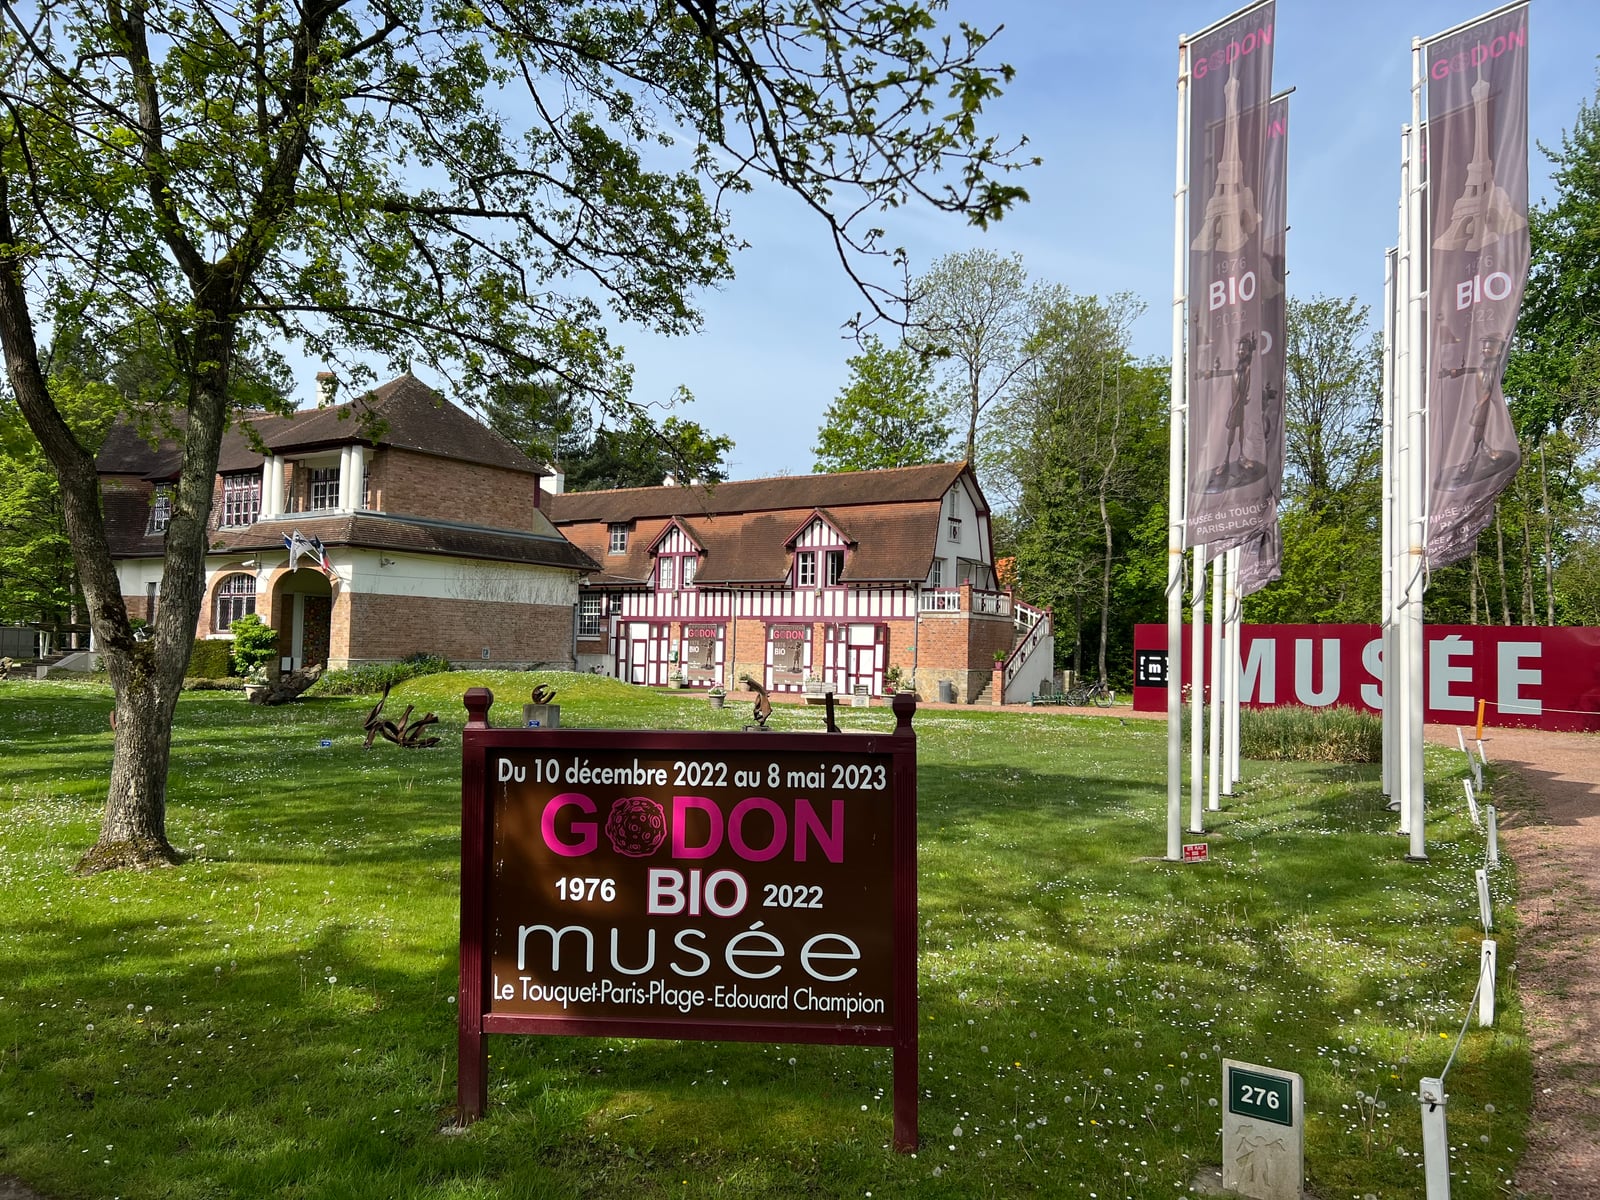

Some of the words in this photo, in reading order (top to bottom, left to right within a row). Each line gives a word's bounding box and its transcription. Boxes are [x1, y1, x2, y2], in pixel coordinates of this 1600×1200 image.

[1216, 257, 1247, 275] 1976
[1209, 271, 1256, 311] BIO
[1456, 271, 1512, 311] BIO
[1214, 511, 1227, 520] du
[498, 757, 526, 783] Du
[534, 758, 560, 784] 10
[566, 757, 668, 786] décembre
[673, 761, 727, 787] 2022
[734, 770, 761, 788] au
[767, 763, 781, 788] 8
[787, 764, 826, 790] mai
[831, 764, 887, 791] 2023
[555, 876, 617, 902] 1976
[647, 867, 748, 918] BIO
[762, 884, 824, 909] 2022
[517, 920, 862, 982] musée
[493, 973, 515, 1001] Le
[793, 986, 885, 1019] Champion
[1240, 1084, 1280, 1110] 276
